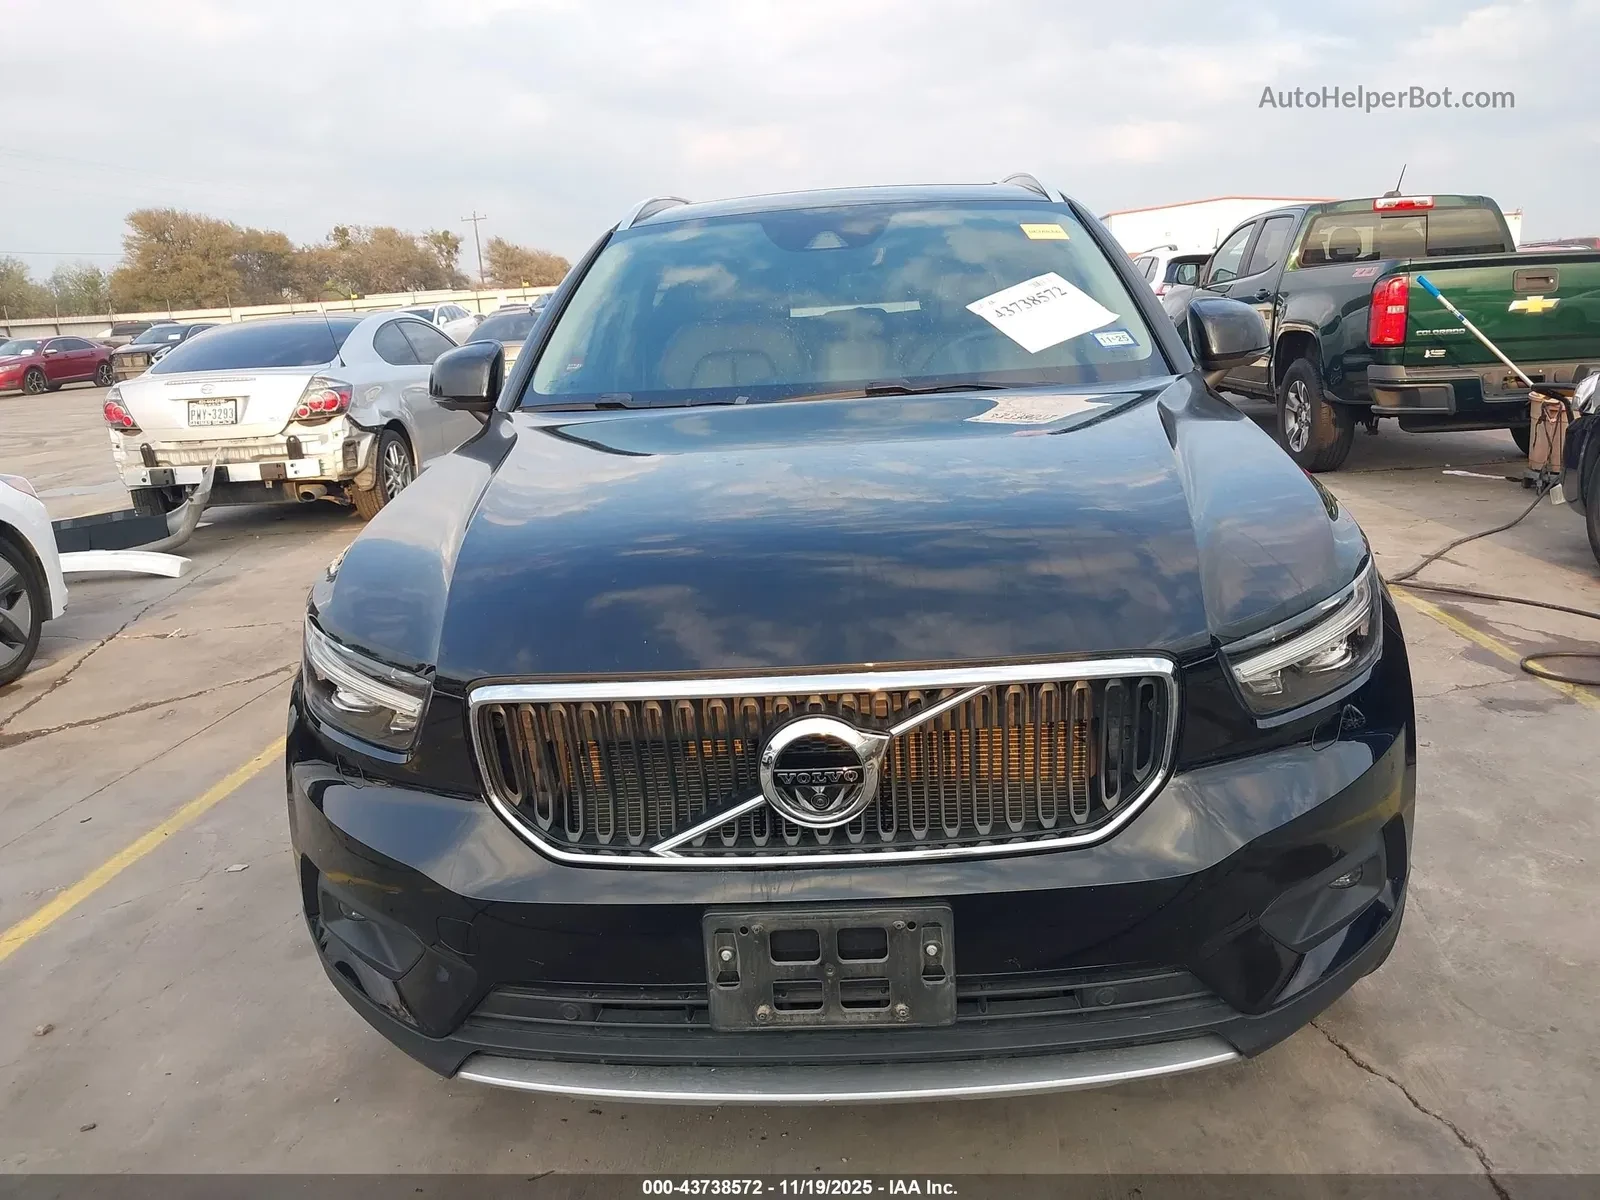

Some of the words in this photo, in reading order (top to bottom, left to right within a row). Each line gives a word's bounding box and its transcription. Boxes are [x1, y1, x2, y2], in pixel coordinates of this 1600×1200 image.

[995, 286, 1068, 317] 43738572
[1416, 328, 1466, 336] COLORADO
[777, 770, 858, 784] VOLVO
